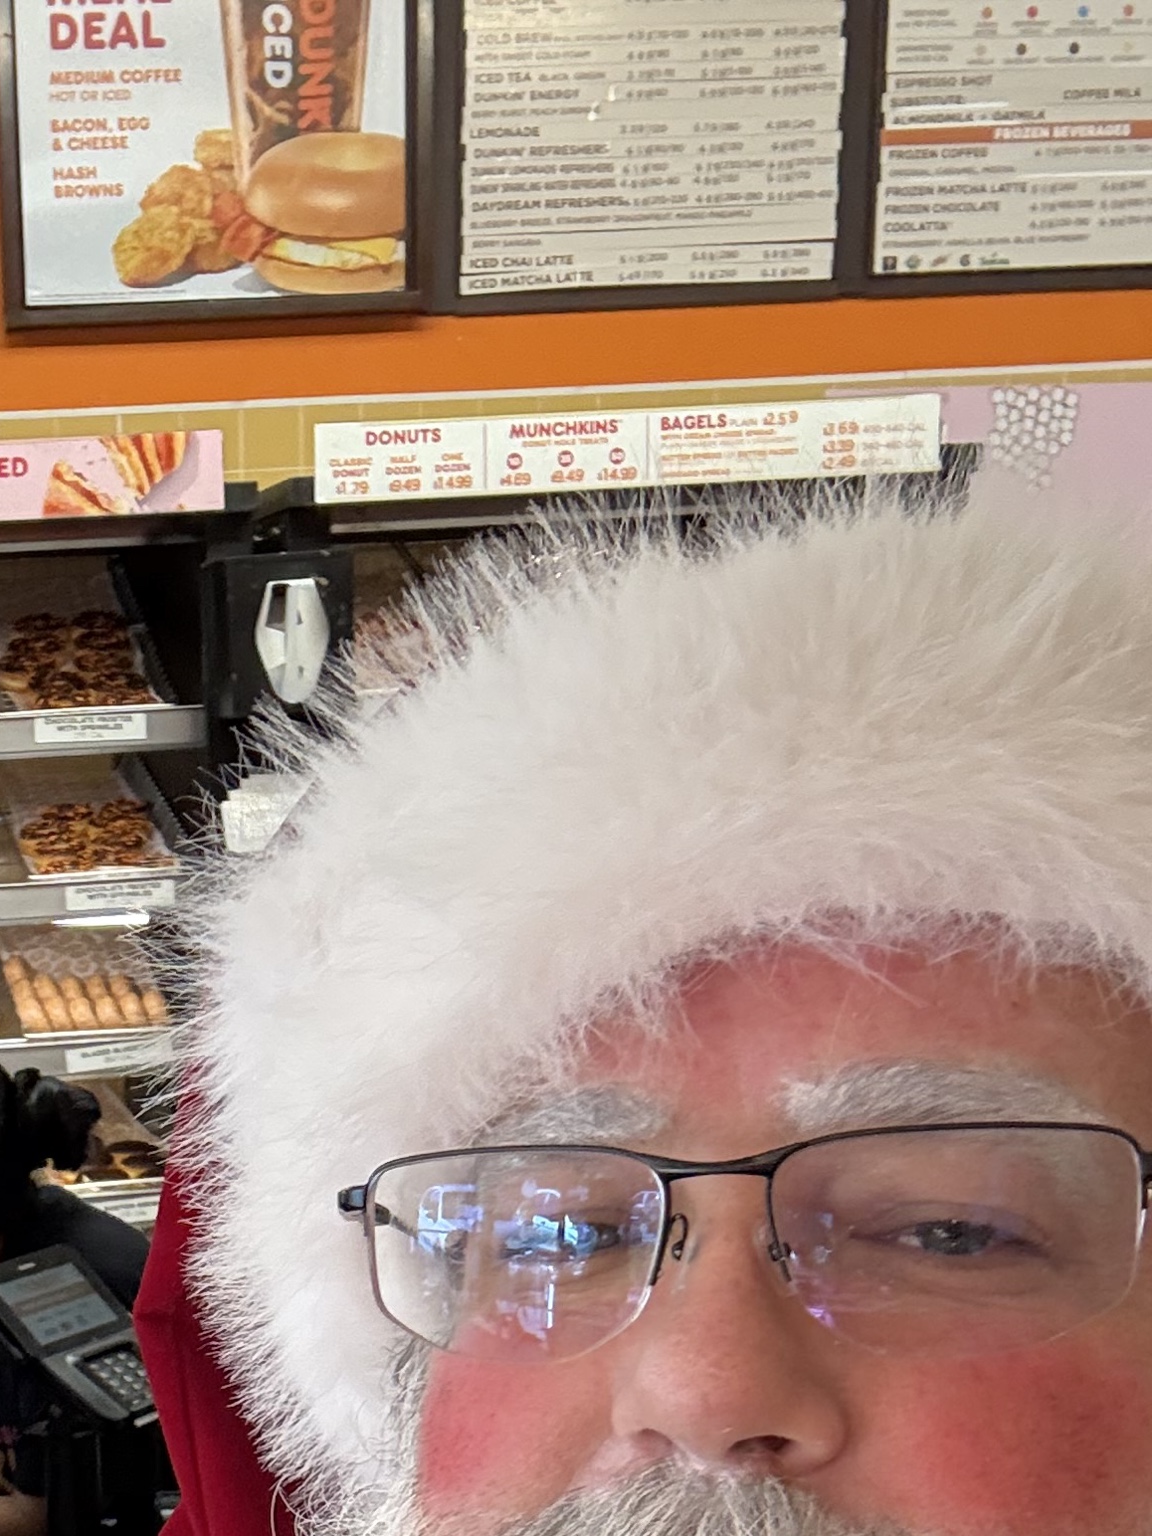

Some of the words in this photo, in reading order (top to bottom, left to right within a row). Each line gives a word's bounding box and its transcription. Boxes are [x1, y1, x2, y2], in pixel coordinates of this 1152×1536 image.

[49, 10, 167, 50] DEAL
[50, 70, 115, 85] MEDIUM
[120, 68, 182, 84] COFFEE
[475, 73, 503, 84] ICED
[507, 72, 531, 83] TEA
[961, 75, 993, 86] SHOT
[51, 91, 76, 101] HOT
[80, 91, 98, 101] OR
[102, 89, 132, 101] ICED
[1063, 88, 1110, 100] COFFEE
[51, 119, 114, 133] BACON,
[118, 116, 150, 131] EGG
[994, 127, 1051, 140] FROZEN
[1053, 123, 1132, 138] BEVERAGES
[470, 127, 540, 139] LEMONADE
[52, 138, 63, 151] &
[67, 136, 129, 151] CHEESE
[888, 149, 938, 160] FROZEN
[941, 147, 989, 159] COFFEE
[53, 166, 97, 180] HASH
[54, 183, 124, 199] BROWNS
[885, 185, 934, 197] FROZEN
[938, 183, 986, 195] MATCHA
[990, 181, 1028, 193] LATTE
[472, 200, 541, 212] DAYDREAM
[932, 201, 1000, 213] CHOCOLATE
[470, 258, 499, 268] ICED
[502, 256, 532, 267] CHAI
[536, 254, 574, 266] LATTE
[469, 278, 497, 289] ICED
[501, 274, 553, 287] MATCHA
[556, 271, 594, 283] LATTE
[509, 419, 619, 438] MUNCHKINS
[660, 414, 727, 431] BAGELS
[365, 428, 442, 446] DONUTS
[329, 457, 373, 468] CLASSIC
[441, 452, 464, 461] ONE
[332, 468, 370, 478] DONUT
[385, 466, 422, 475] DOZEN
[434, 463, 472, 473] DOZEN
